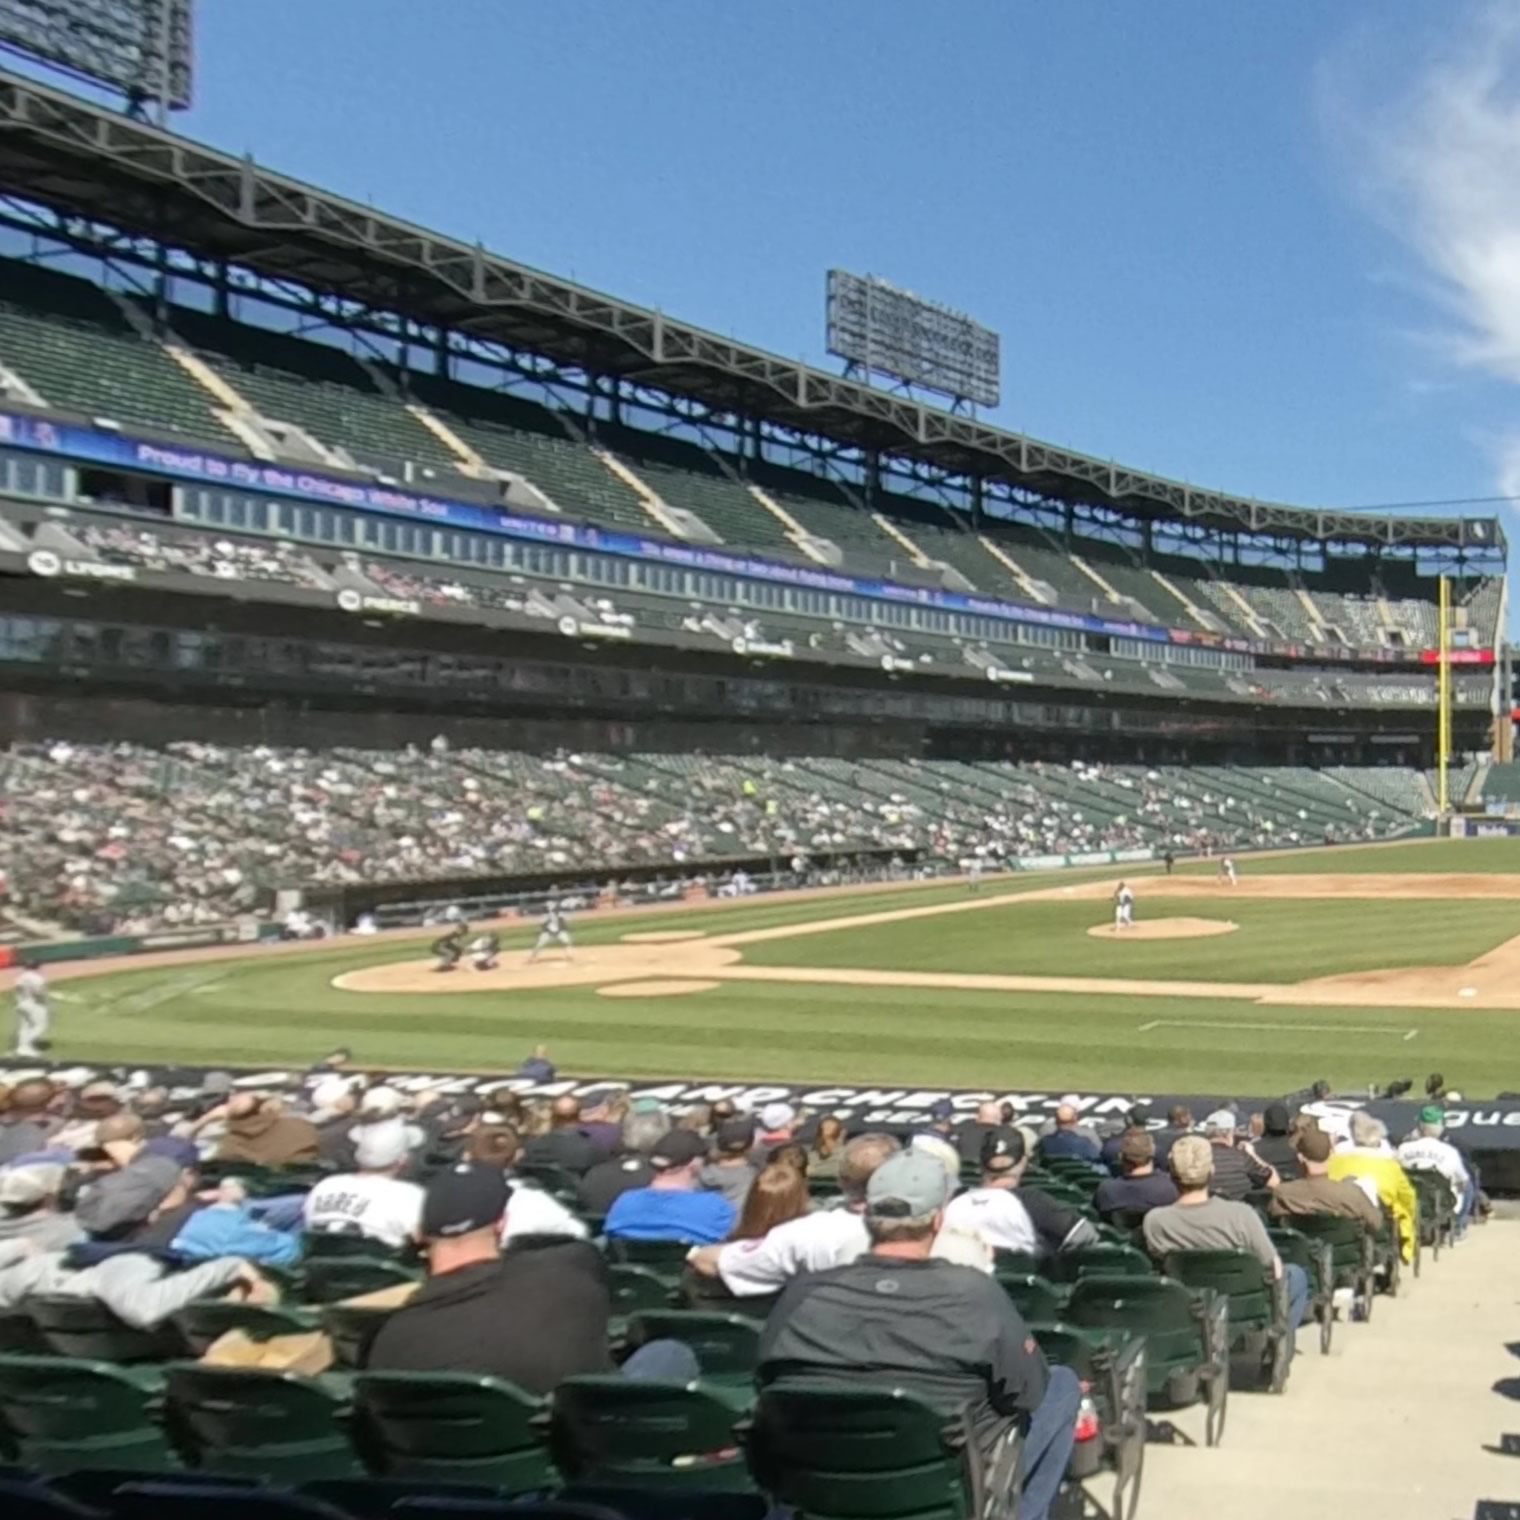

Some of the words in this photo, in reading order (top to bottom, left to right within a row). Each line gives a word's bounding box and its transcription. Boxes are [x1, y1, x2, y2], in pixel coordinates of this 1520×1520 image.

[138, 444, 203, 471] Proud
[297, 474, 366, 501] Chicago
[369, 485, 418, 511] White
